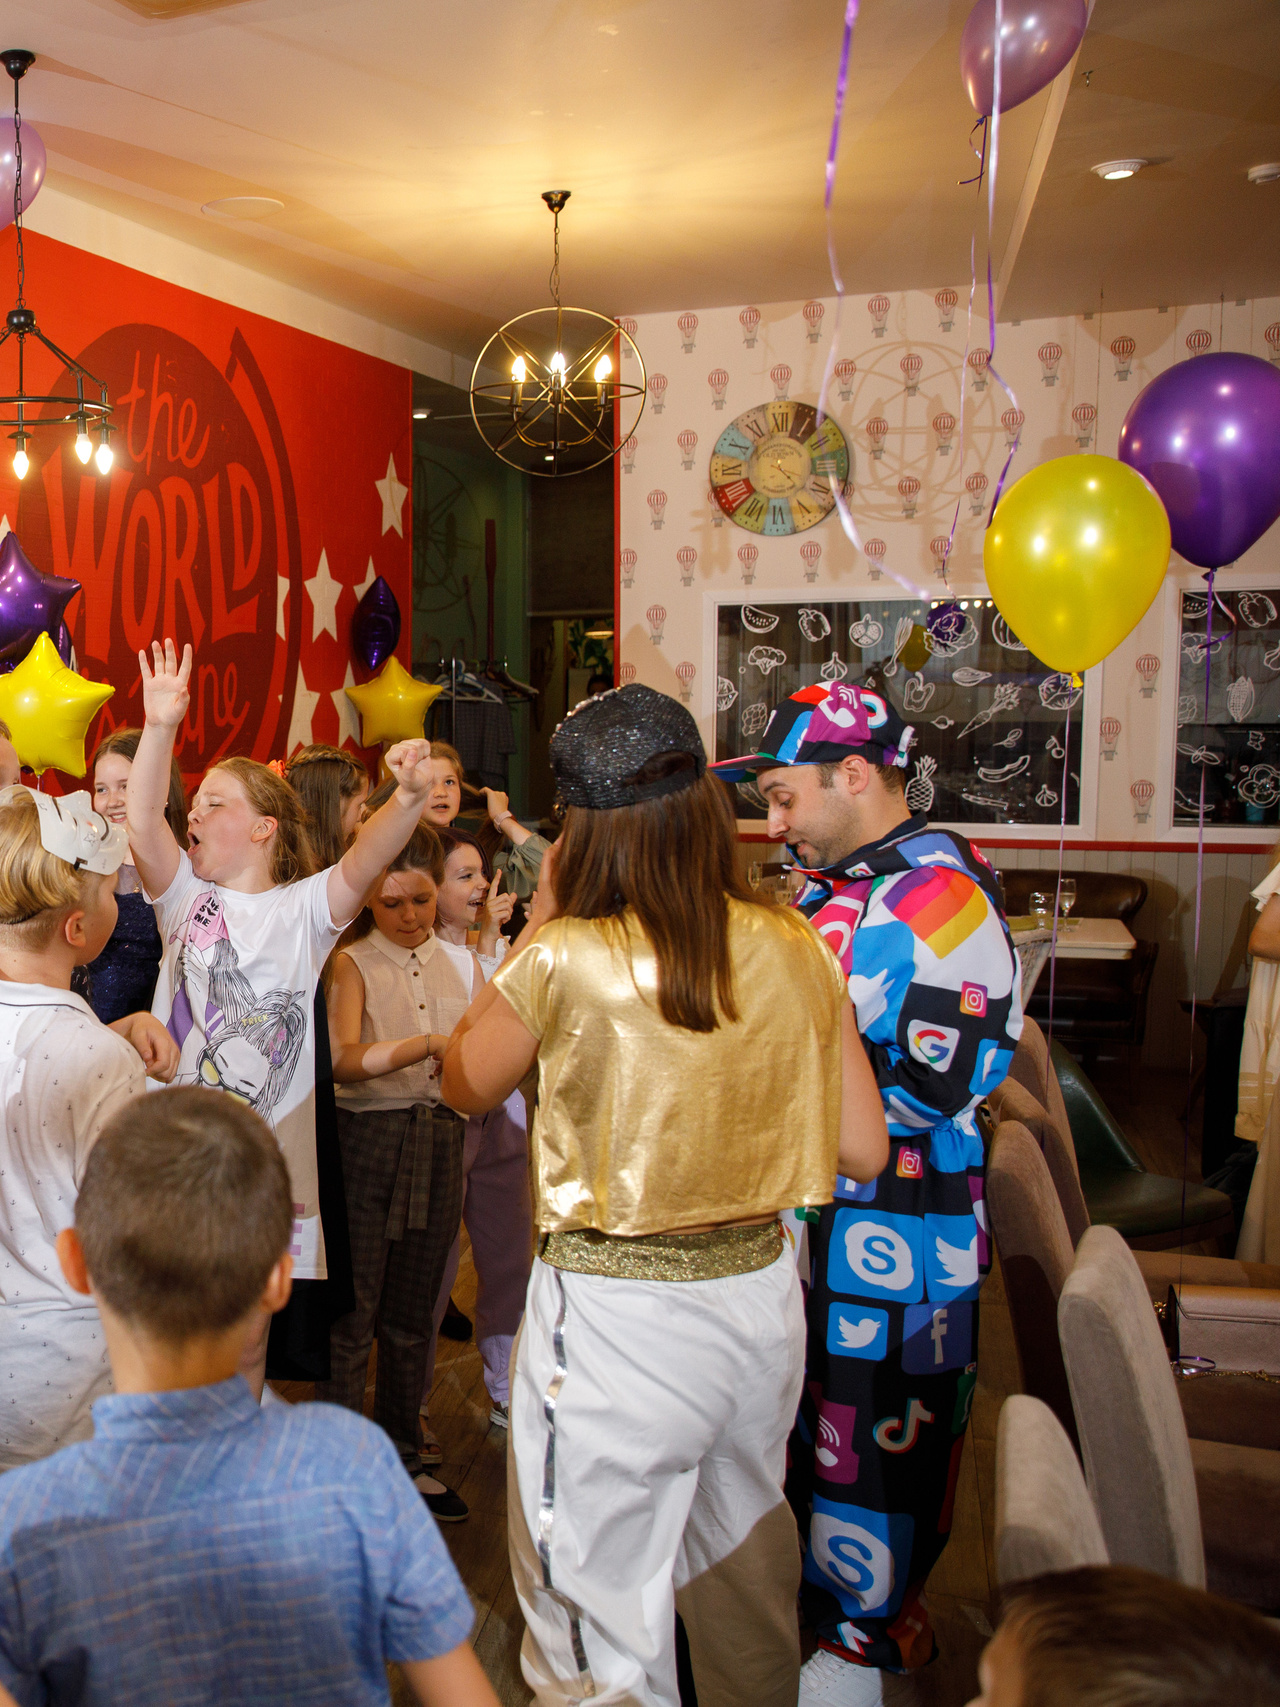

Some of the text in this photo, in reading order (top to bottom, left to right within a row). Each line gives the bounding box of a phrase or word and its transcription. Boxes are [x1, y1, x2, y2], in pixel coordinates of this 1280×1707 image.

[117, 349, 210, 475] the
[771, 412, 789, 432] XII
[772, 505, 785, 525] VI
[41, 444, 262, 664] WORLD
[241, 1013, 269, 1027] TRICK
[914, 1029, 950, 1064] G
[861, 1235, 897, 1275] S
[930, 1308, 948, 1365] f
[827, 1534, 874, 1592] S
